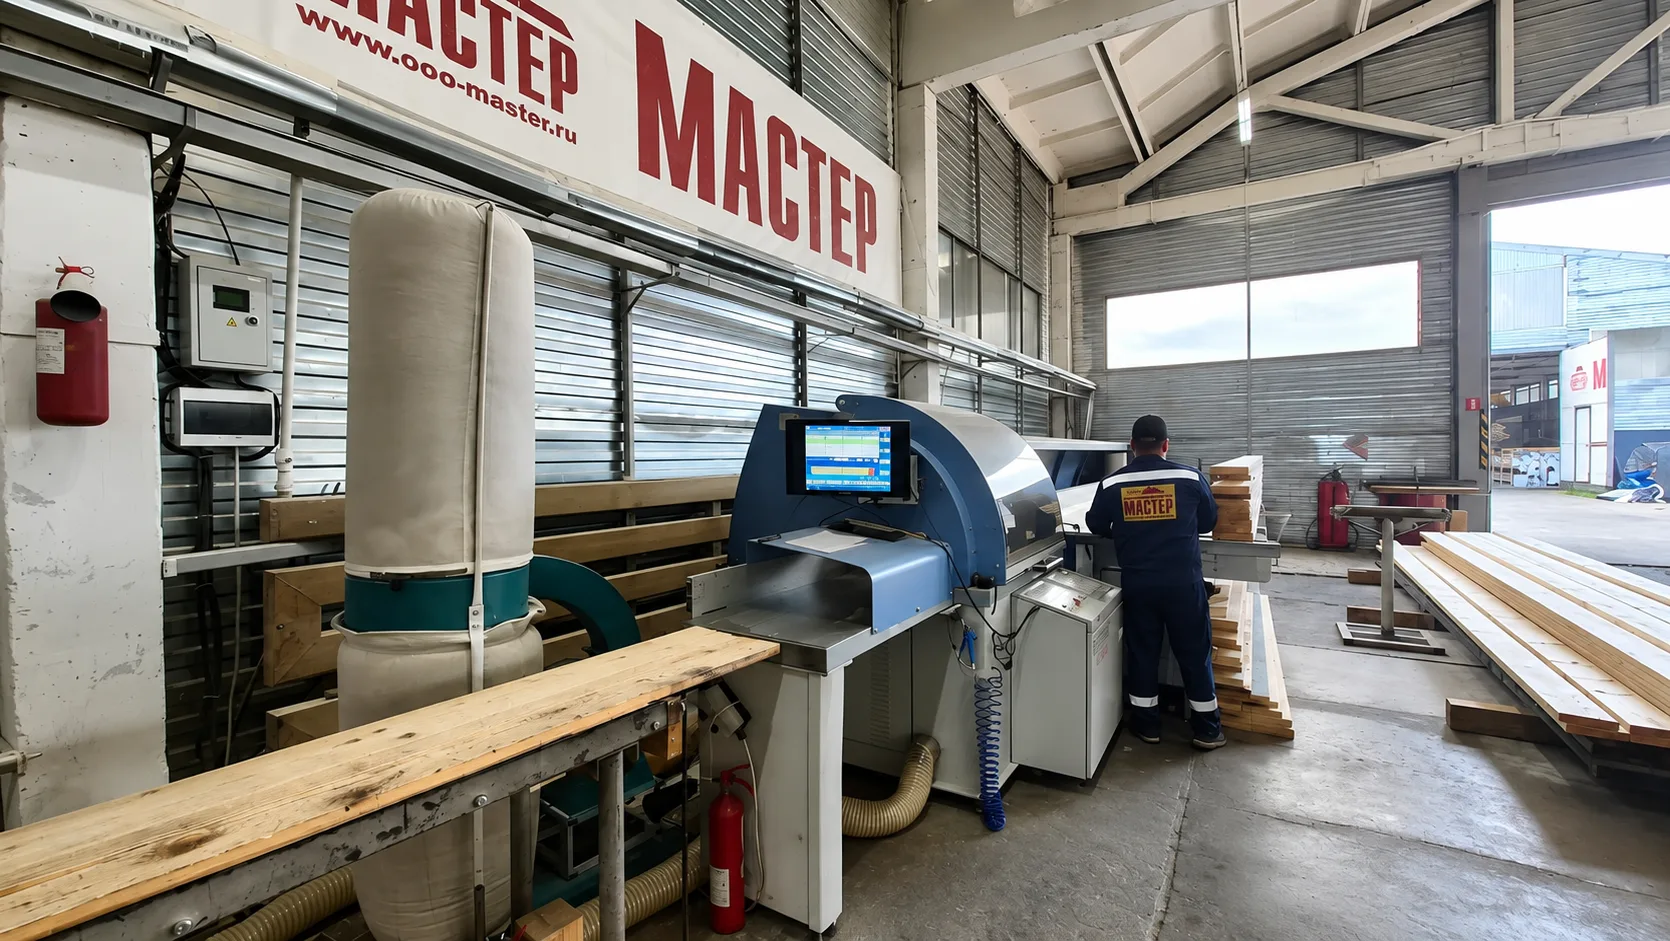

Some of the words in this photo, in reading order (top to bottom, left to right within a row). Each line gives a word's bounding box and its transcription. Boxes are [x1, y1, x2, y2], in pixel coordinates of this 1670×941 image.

[296, 3, 577, 145] www.ooo-master.ru
[330, 0, 578, 114] АСТЕР
[635, 19, 877, 274] МАСТЕР
[1124, 499, 1173, 516] МАСТЕР
